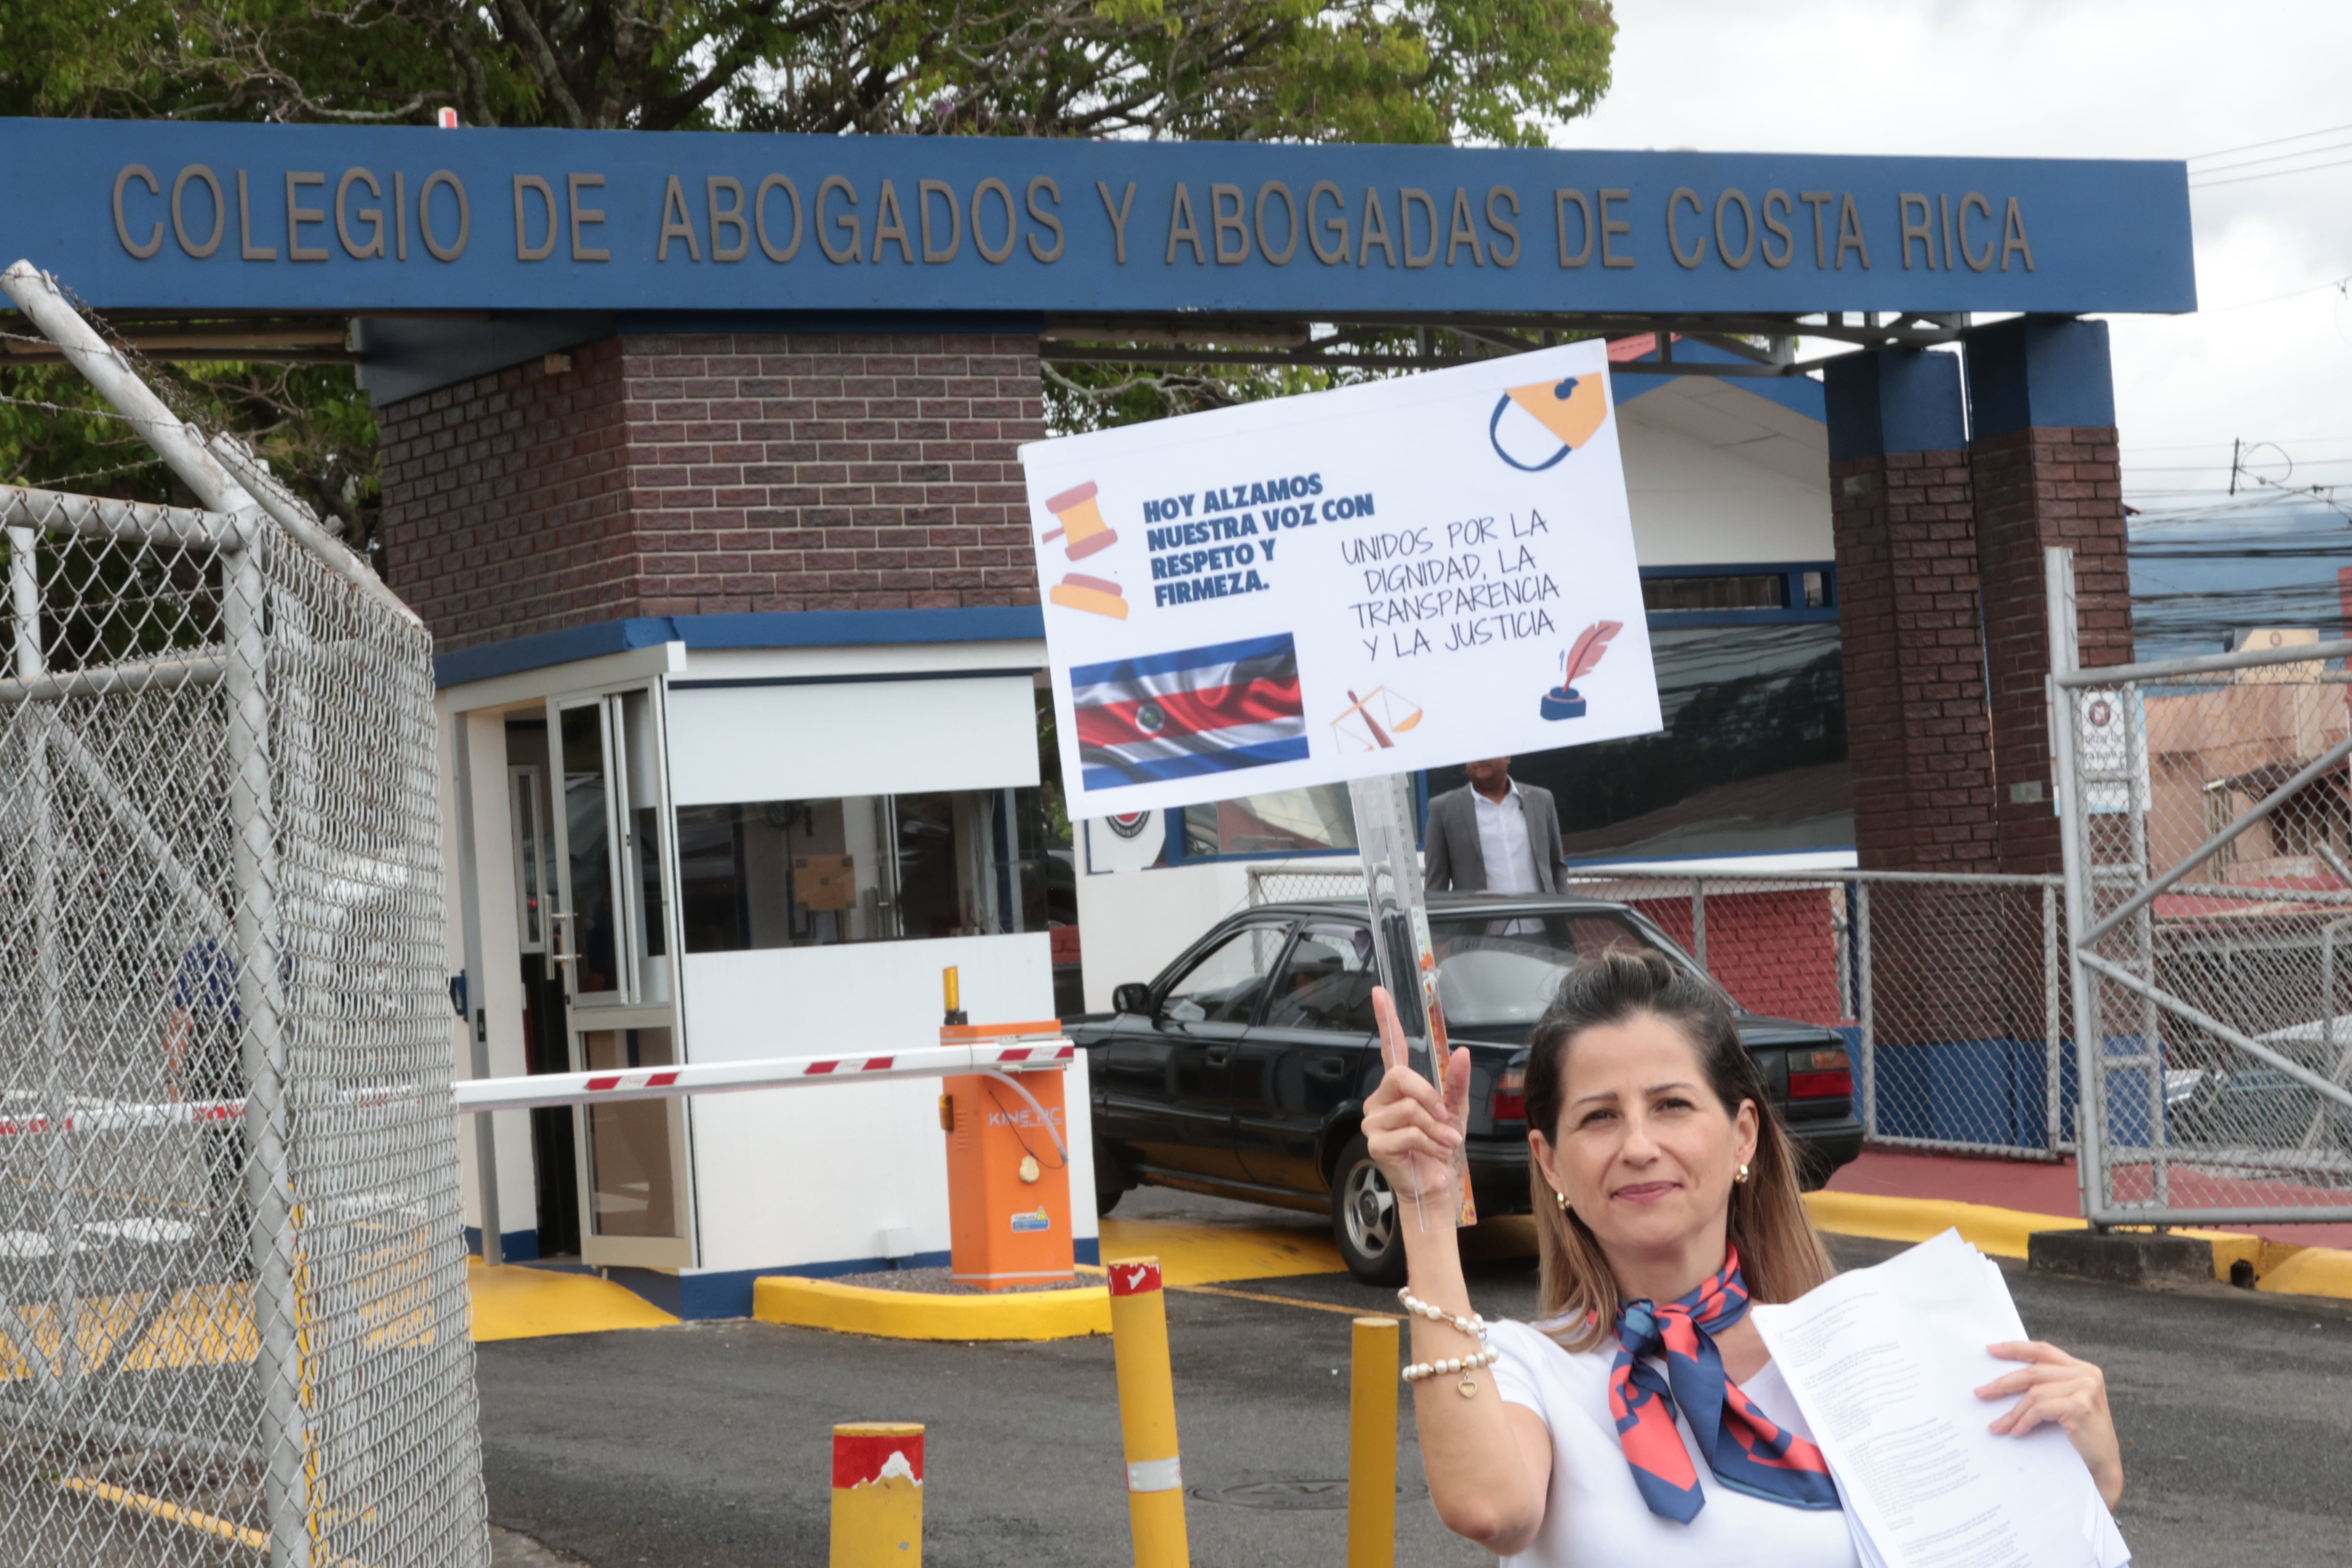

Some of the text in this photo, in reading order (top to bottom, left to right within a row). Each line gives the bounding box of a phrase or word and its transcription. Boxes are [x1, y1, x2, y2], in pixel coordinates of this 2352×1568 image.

[113, 163, 2035, 273] COLEGIO DE ABOGADOS Y ABOGADAS DE COSTA RICA
[1143, 472, 1324, 524] HOY ALZAMOS
[1146, 493, 1375, 552] NUESTRA VOZ CON
[1150, 537, 1276, 581] RESPETO Y
[1342, 508, 1549, 565] UNIDOS POR LA
[1153, 568, 1271, 608] FIRMEZA.
[1363, 544, 1536, 595] DIGNIDAD, LA
[1348, 573, 1560, 629] TRANSPARENCIA
[1362, 608, 1556, 662] Y LA JUSTICIA
